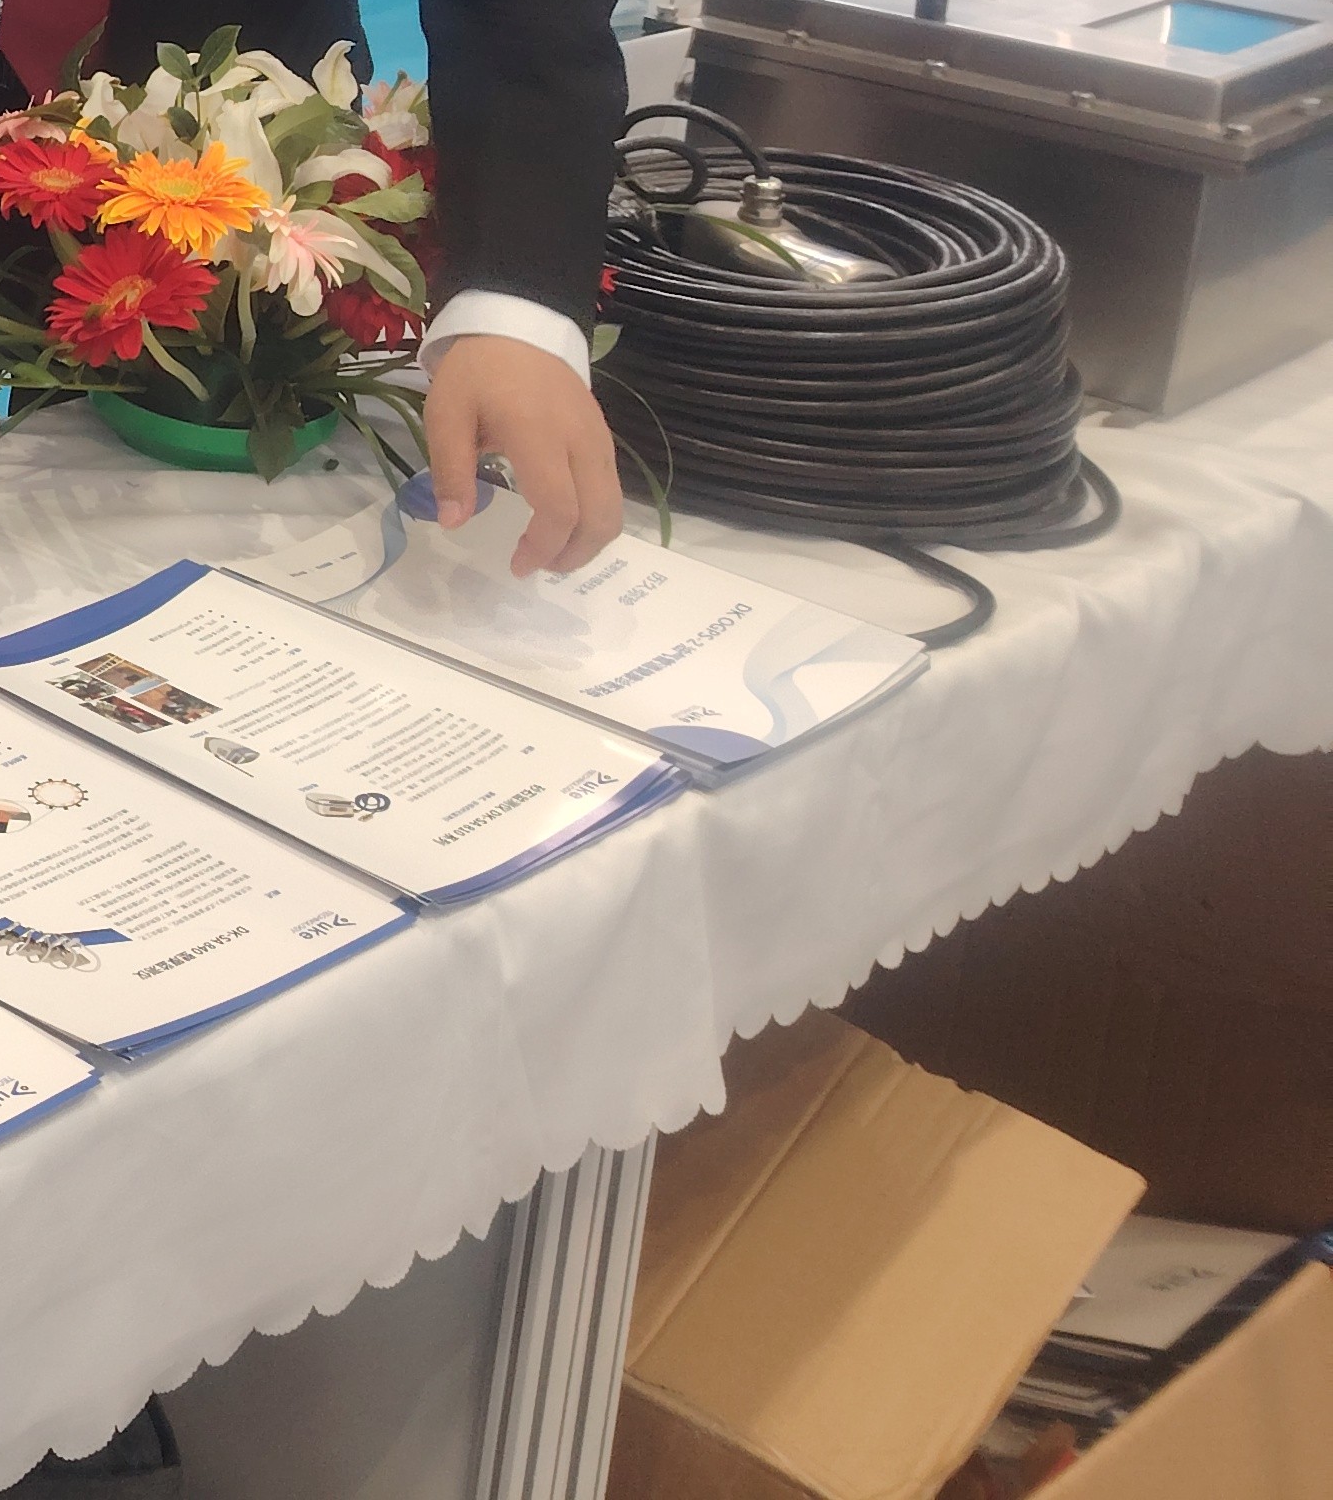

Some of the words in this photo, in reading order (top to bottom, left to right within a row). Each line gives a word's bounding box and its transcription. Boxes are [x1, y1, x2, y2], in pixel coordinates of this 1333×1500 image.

[725, 601, 754, 620] DK
[466, 808, 504, 828] DK-SA
[450, 823, 477, 837] 810
[430, 832, 460, 847] 系列
[209, 925, 250, 945] DK-SA
[188, 941, 217, 955] 840
